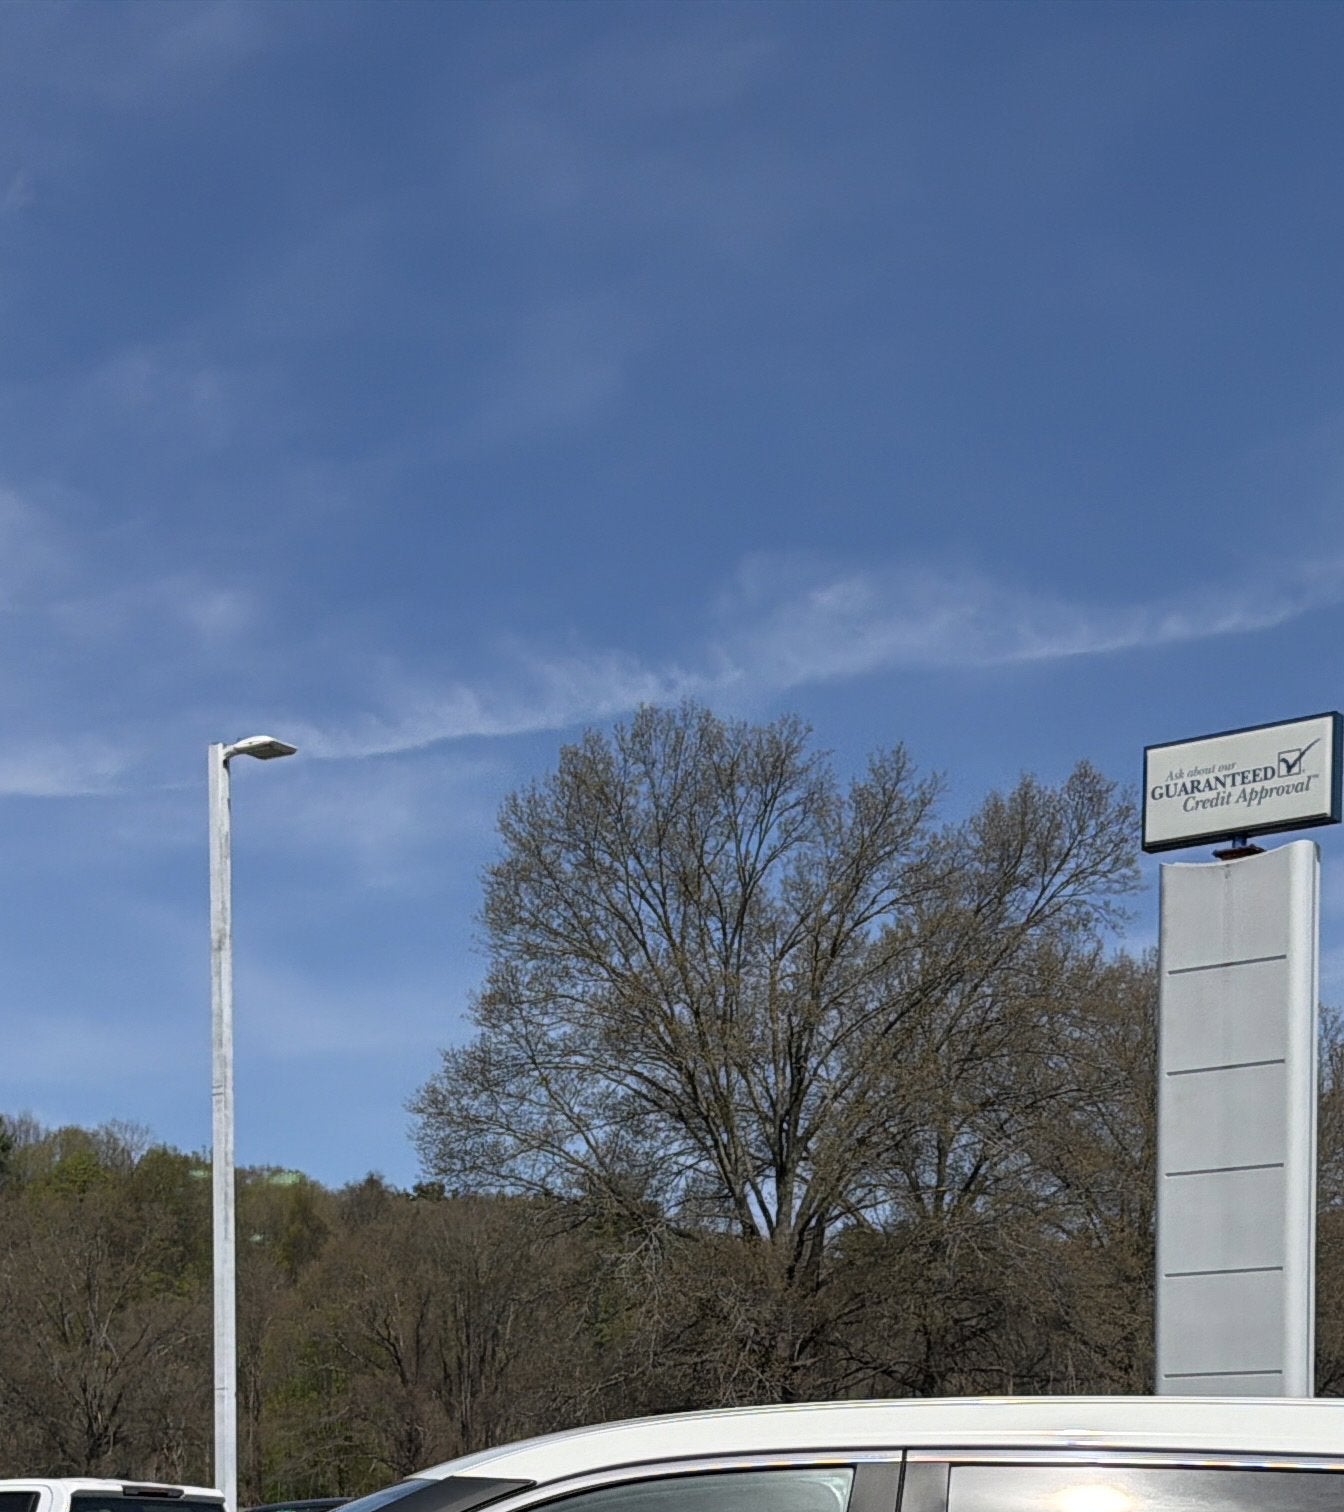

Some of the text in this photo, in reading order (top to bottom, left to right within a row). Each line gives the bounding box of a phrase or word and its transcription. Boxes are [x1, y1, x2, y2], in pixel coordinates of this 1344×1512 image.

[1151, 766, 1276, 800] GUARANTEED
[1165, 761, 1236, 782] Ask about our
[1182, 776, 1312, 813] Credit Approval
